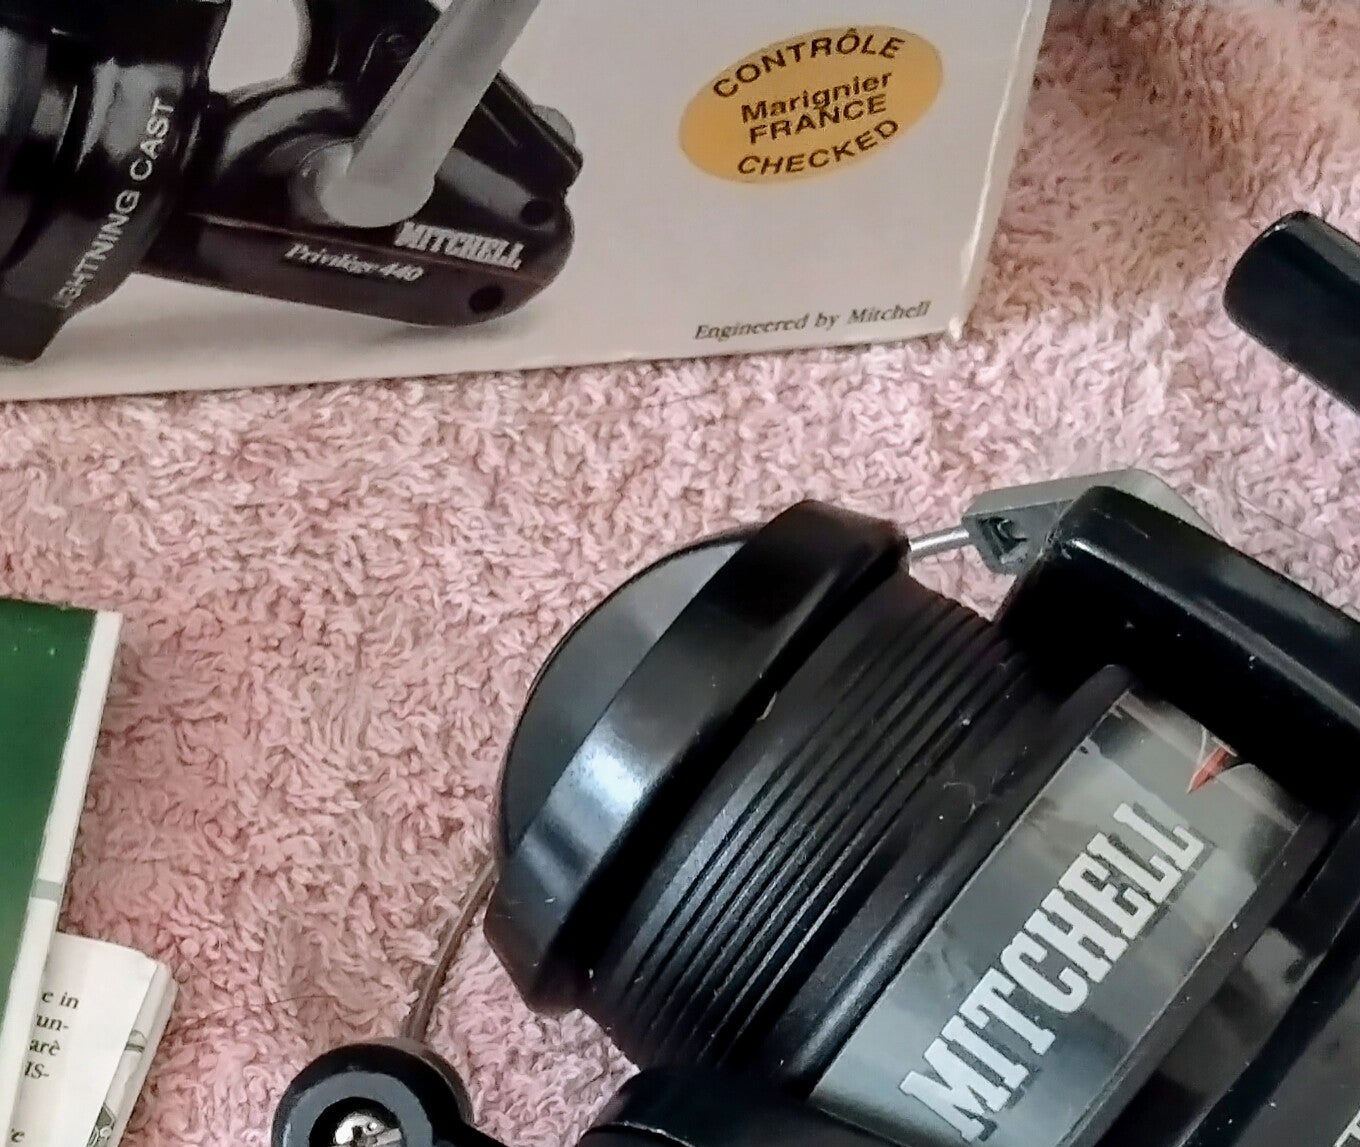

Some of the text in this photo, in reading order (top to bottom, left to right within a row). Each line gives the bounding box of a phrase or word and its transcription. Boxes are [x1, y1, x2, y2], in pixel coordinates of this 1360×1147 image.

[713, 27, 906, 99] CONTRÔLE
[741, 70, 894, 124] Marignier
[749, 93, 888, 145] FRANCE
[129, 96, 178, 182] CAST
[737, 118, 900, 176] CHECKED
[394, 220, 525, 271] MITCHELL
[695, 300, 933, 342] Engineered by Mitchell
[897, 801, 1213, 1144] MITCHELL
